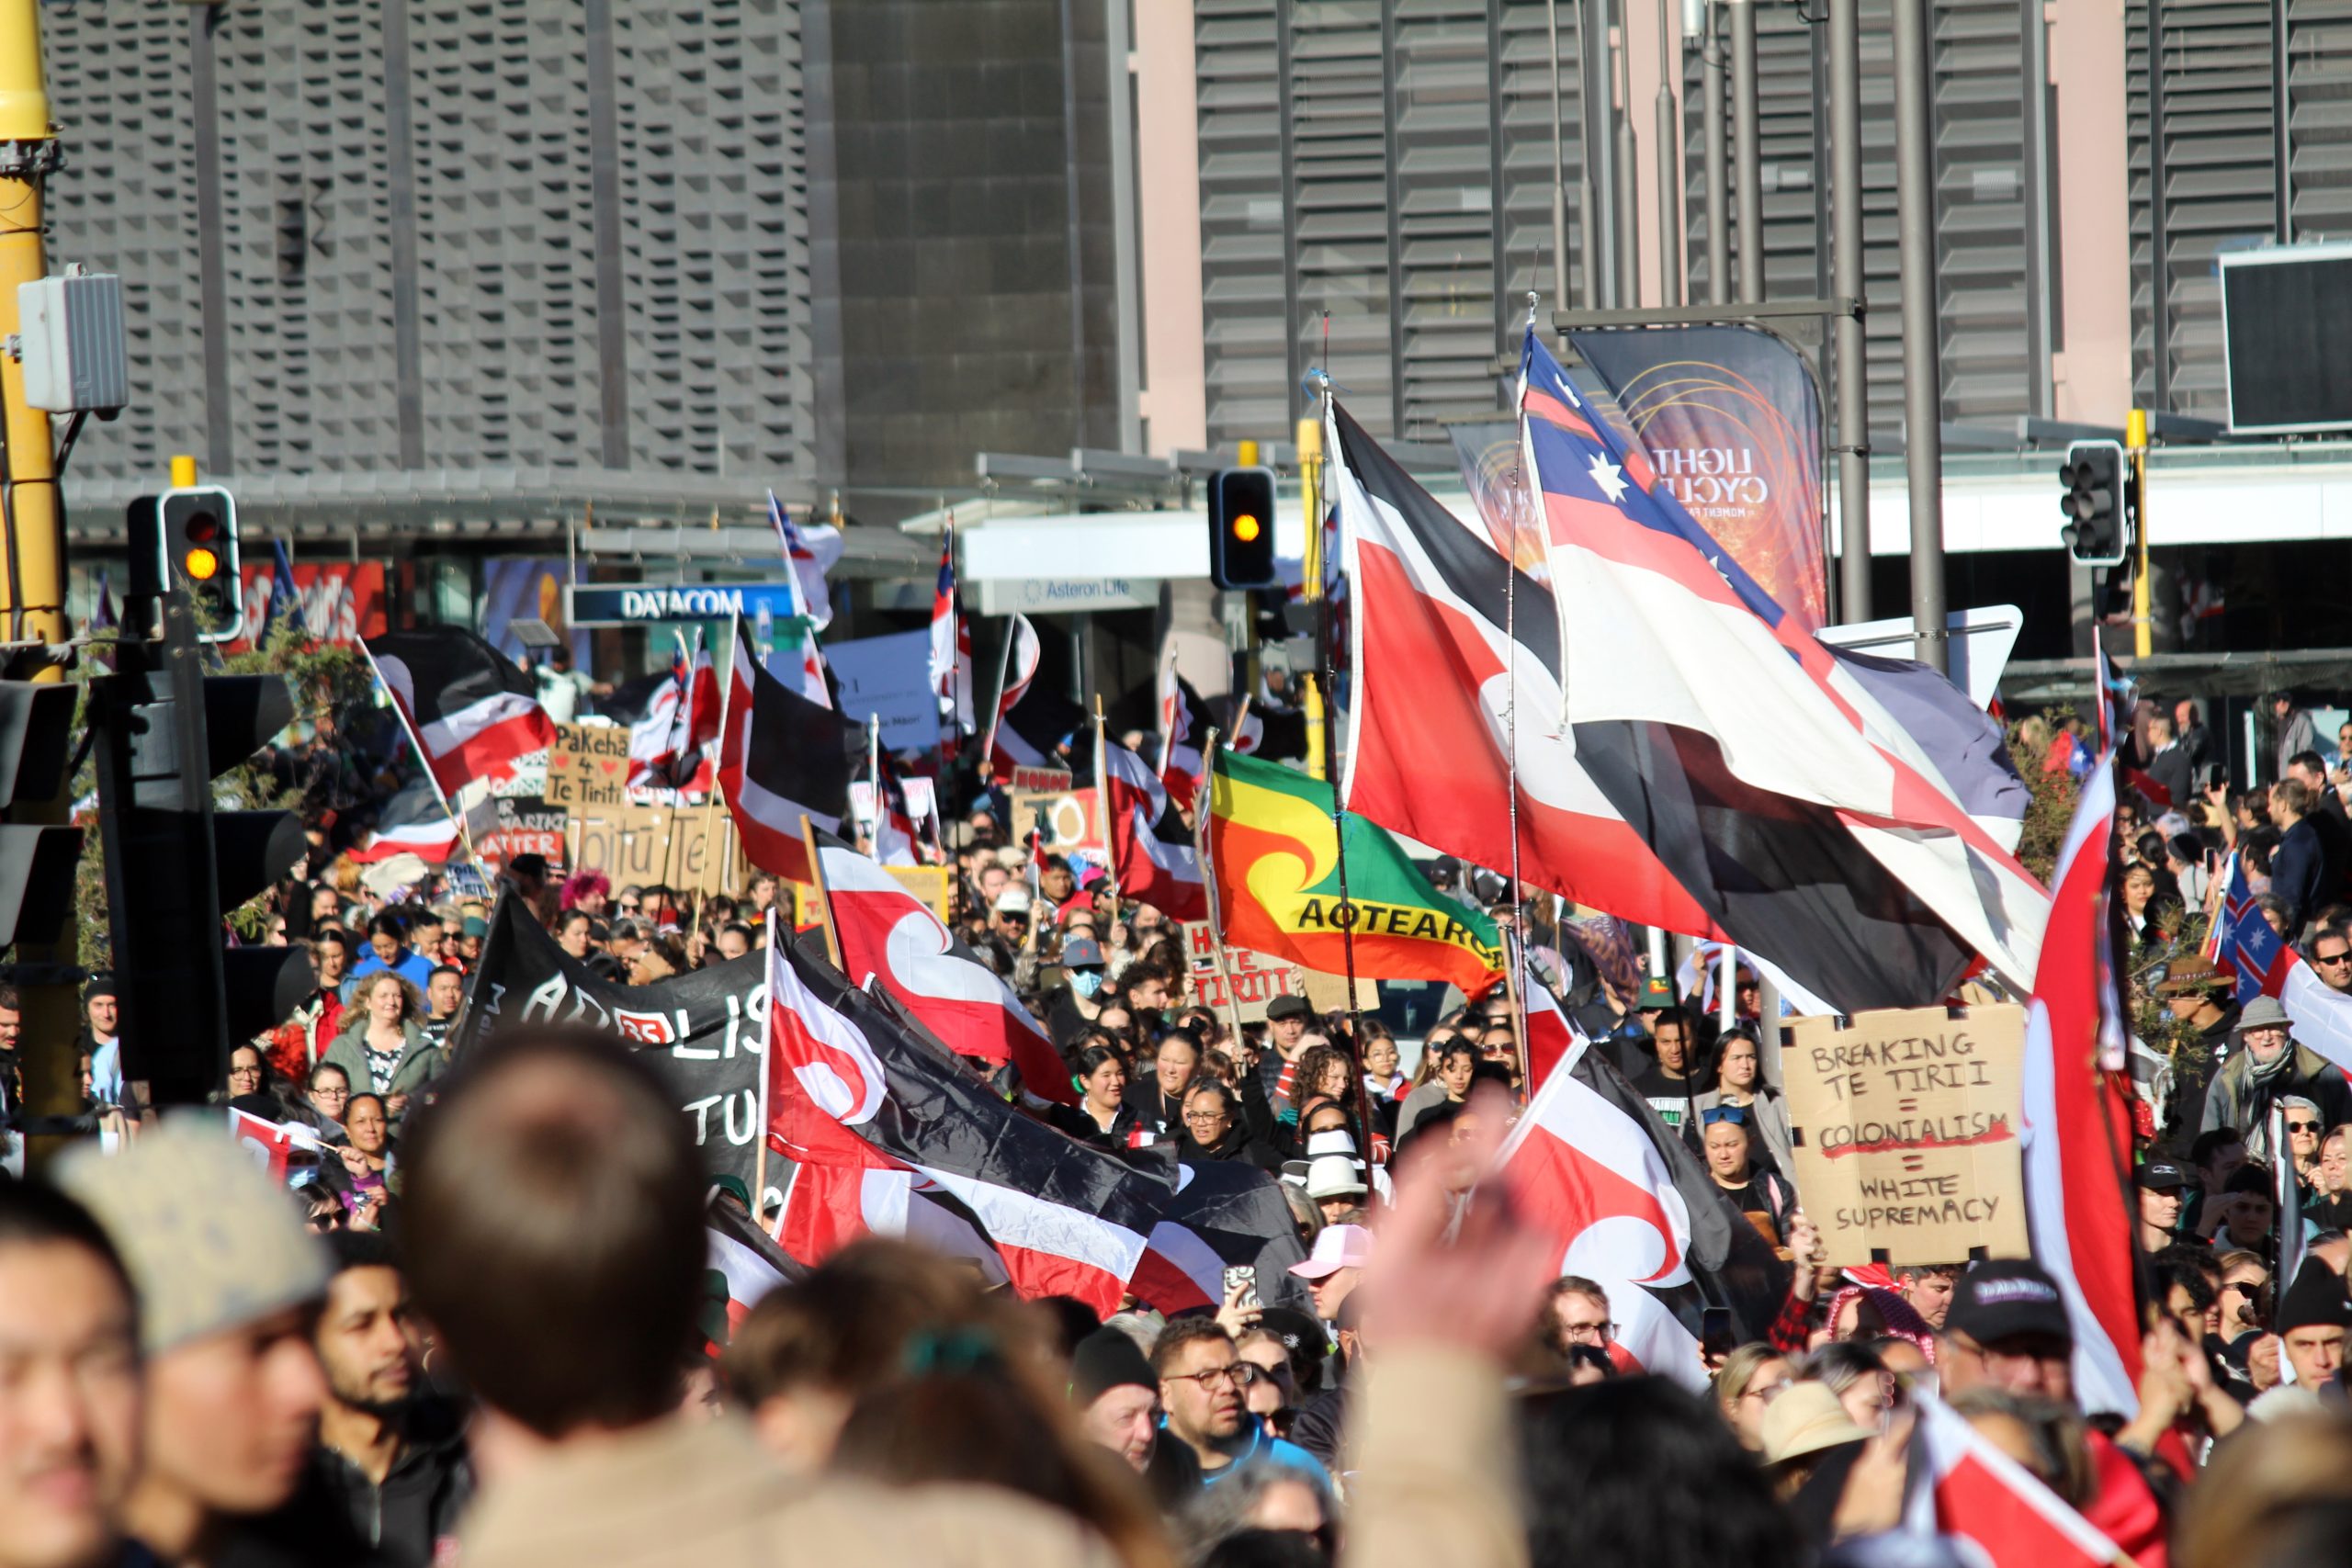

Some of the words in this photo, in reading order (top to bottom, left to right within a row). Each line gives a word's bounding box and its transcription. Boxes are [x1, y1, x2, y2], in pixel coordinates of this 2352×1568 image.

[1046, 581, 1101, 598] Asteron
[1104, 578, 1131, 596] Life
[621, 589, 744, 619] DATACOM
[578, 755, 594, 774] 4
[549, 774, 572, 801] Te
[578, 777, 623, 806] Tiriti
[1811, 1032, 1976, 1074] BREAKING
[1824, 1072, 1869, 1101] TE
[1819, 1112, 2009, 1150] COLONIALISM
[1860, 1174, 1961, 1201] WHITE
[1836, 1196, 2000, 1231] SUPREMACY
